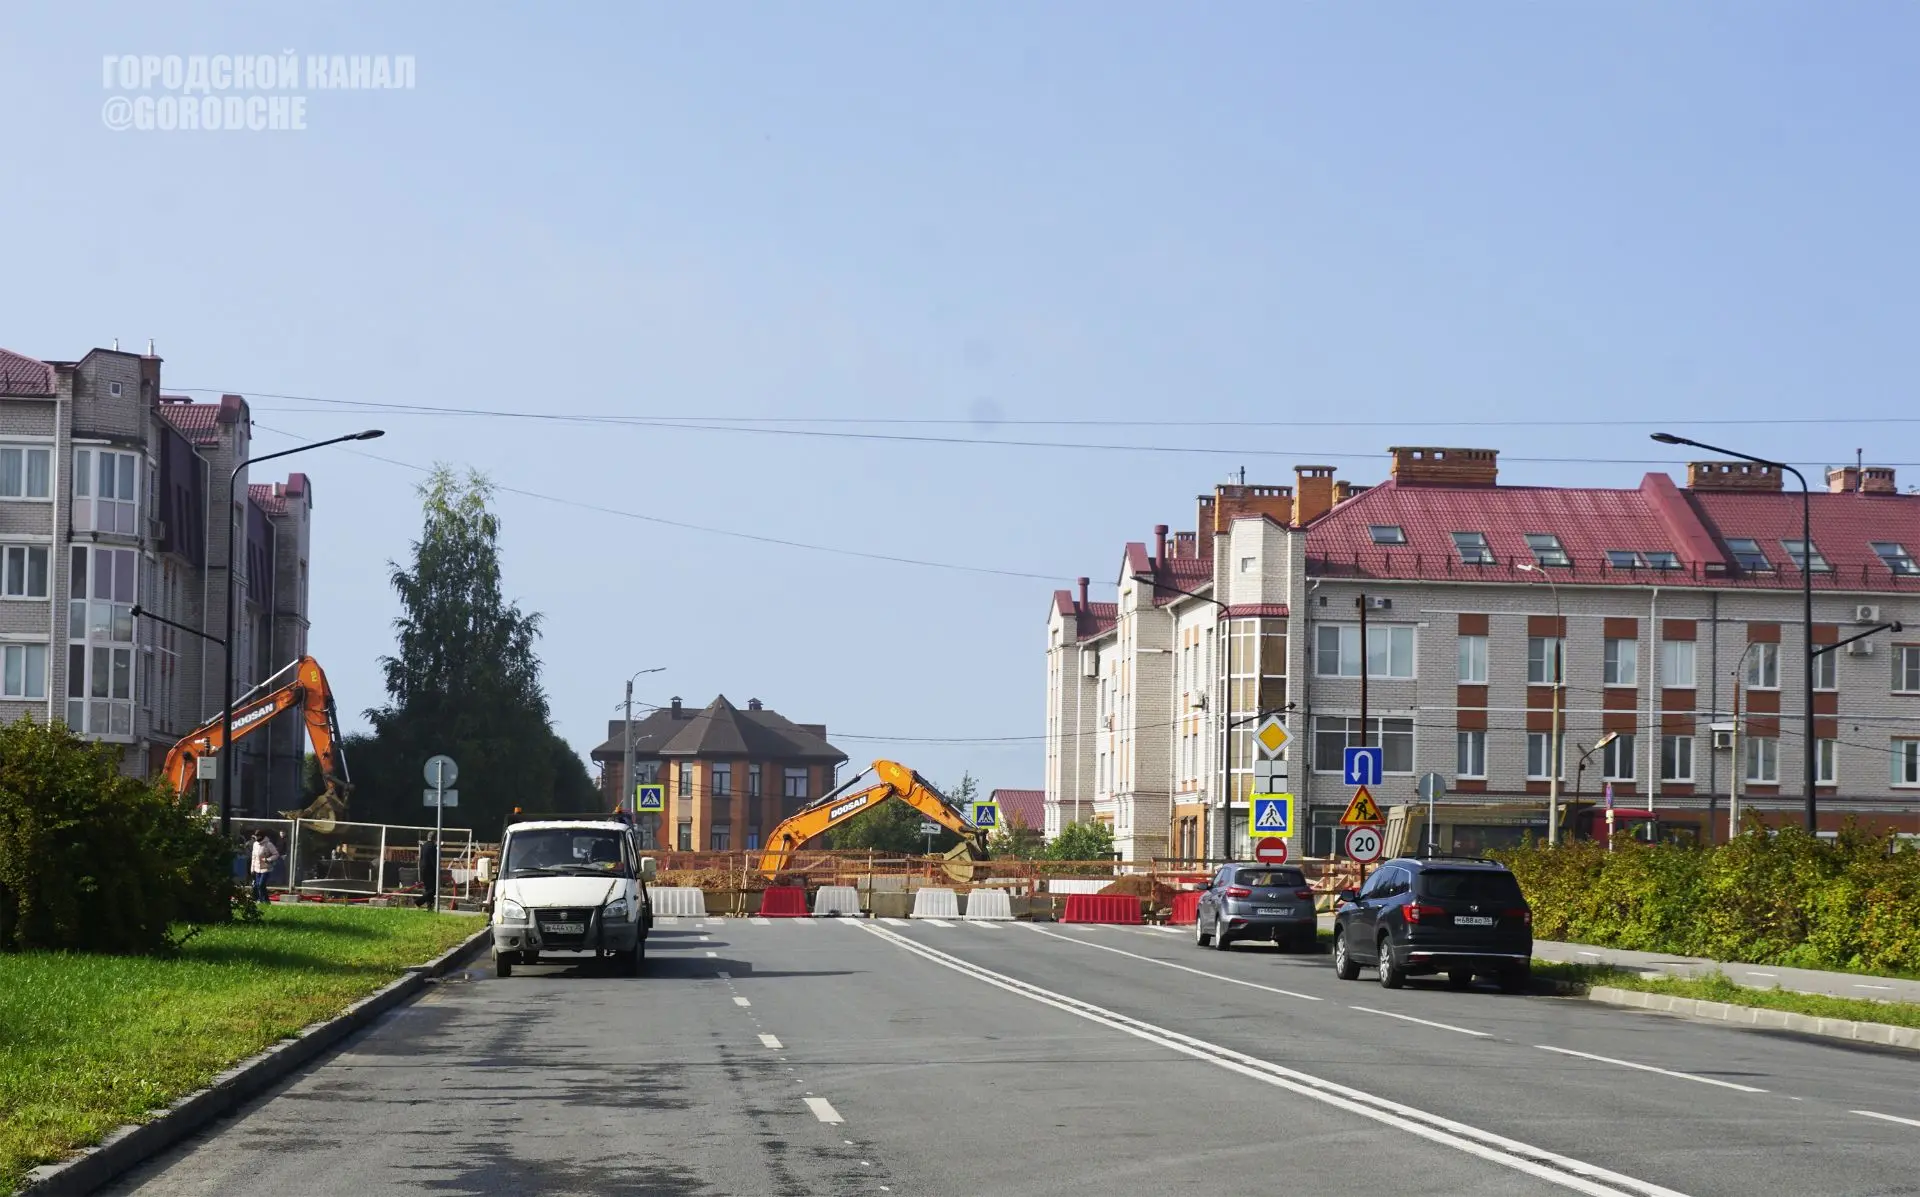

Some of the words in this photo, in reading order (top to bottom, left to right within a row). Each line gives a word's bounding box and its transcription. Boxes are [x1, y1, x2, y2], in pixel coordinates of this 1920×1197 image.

[231, 703, 274, 731] DOOSAN
[831, 795, 867, 819] DOOSAN
[1354, 836, 1375, 852] 20
